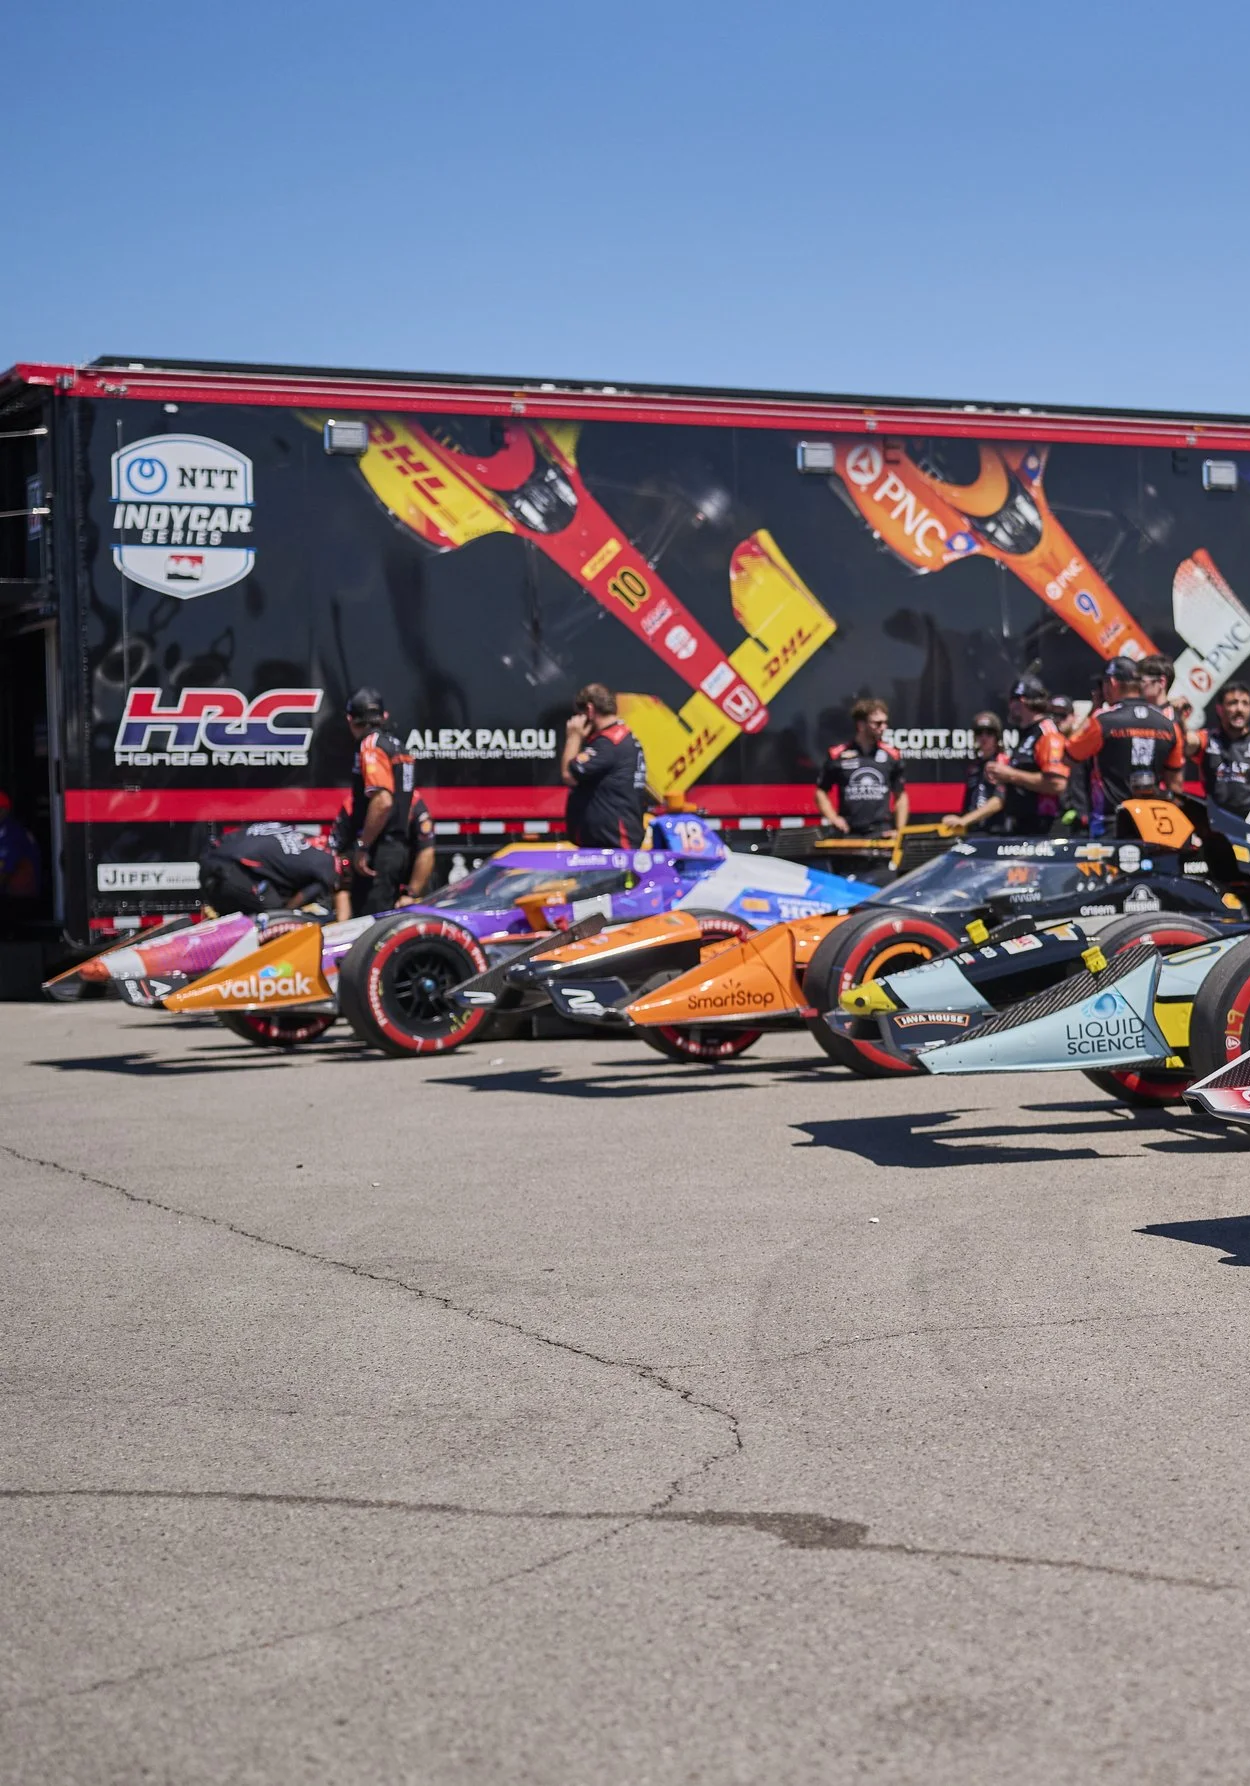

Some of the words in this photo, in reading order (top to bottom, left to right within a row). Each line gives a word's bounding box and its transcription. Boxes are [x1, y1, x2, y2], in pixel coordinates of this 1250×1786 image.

[178, 466, 238, 488] NTT
[113, 503, 253, 533] INDYCAR
[872, 473, 947, 559] PNC
[141, 529, 222, 546] SERIES
[1055, 556, 1085, 590] PNC
[609, 567, 651, 612] 10
[1074, 589, 1101, 624] 9
[762, 627, 812, 679] DHL
[114, 687, 324, 752] HRC
[405, 728, 472, 750] ALEX
[475, 728, 557, 750] PALOU
[668, 727, 718, 780] DHL
[881, 728, 950, 750] SCOTT
[952, 729, 1020, 750] DIN
[115, 751, 208, 767] Honda
[211, 751, 309, 767] RACING
[1151, 806, 1174, 836] 5
[674, 821, 705, 855] 18
[104, 870, 166, 885] JIFFY
[217, 970, 313, 1002] valpak
[688, 989, 776, 1011] SmartStop
[900, 1013, 926, 1026] JAVA
[928, 1012, 966, 1024] HOUSE
[1066, 1016, 1146, 1041] LIQUID
[1066, 1034, 1147, 1056] SCIENCE
